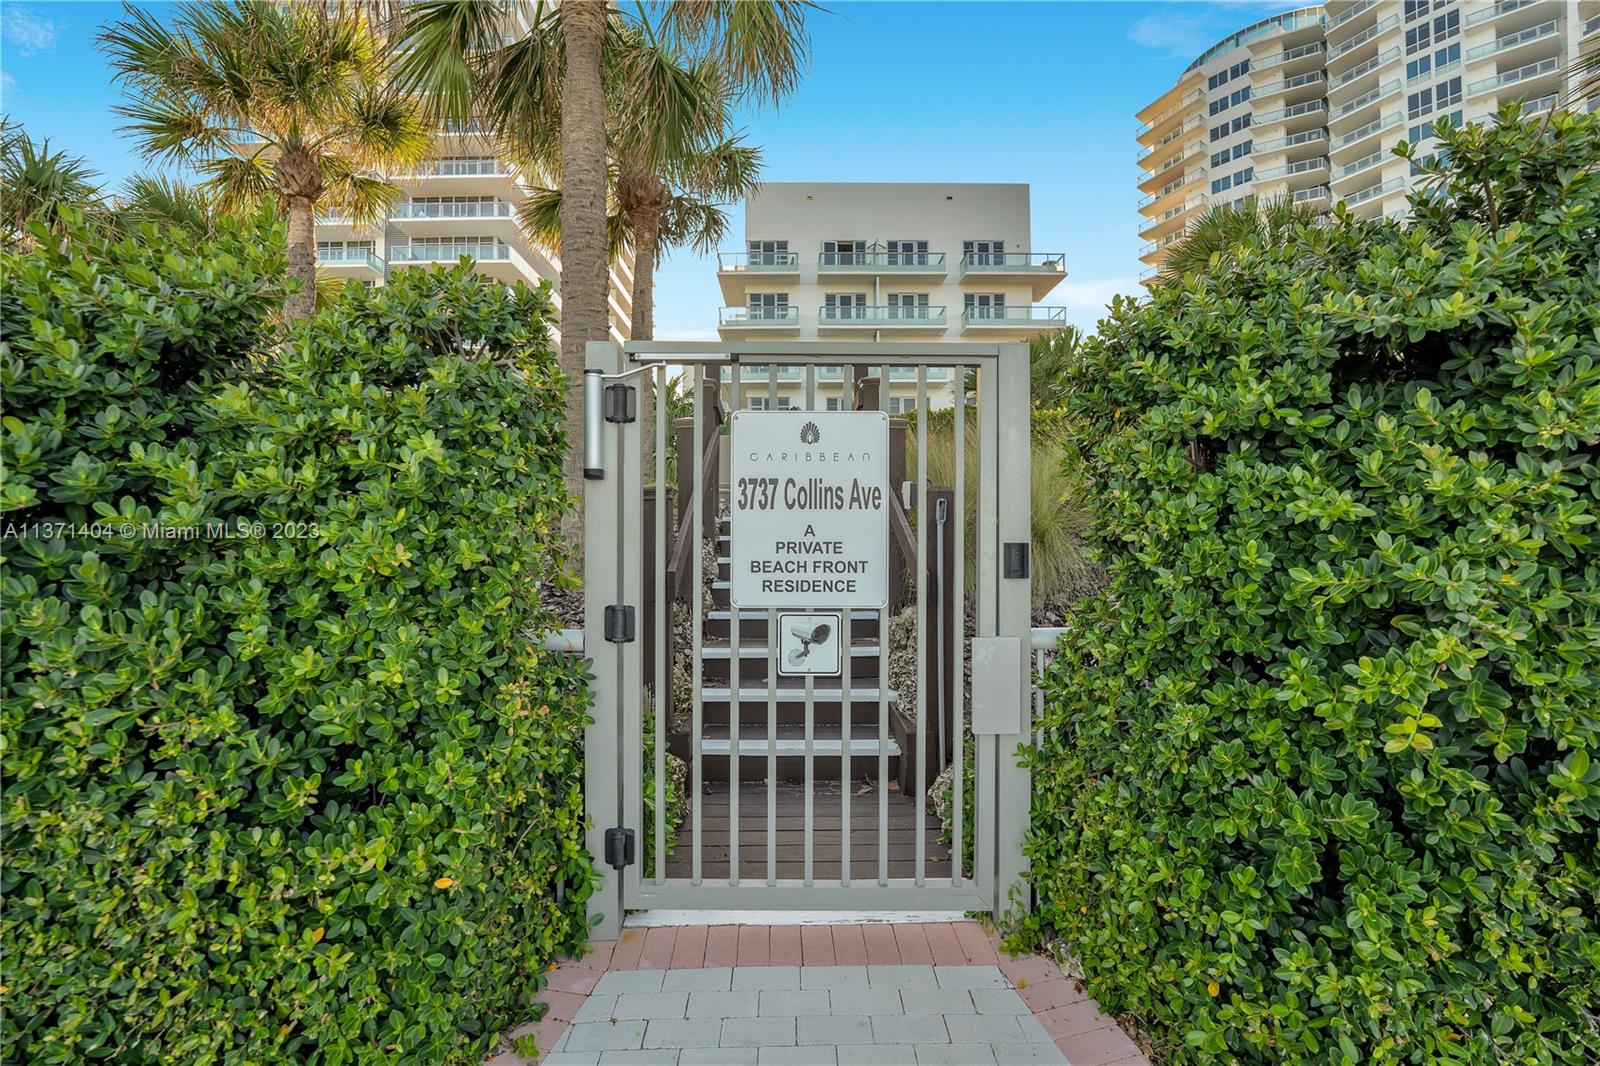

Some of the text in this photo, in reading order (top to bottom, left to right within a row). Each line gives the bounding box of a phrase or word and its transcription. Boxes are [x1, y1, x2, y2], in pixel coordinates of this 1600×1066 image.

[750, 452, 870, 462] CARIBBEAN
[738, 477, 882, 511] 3737 Collins Ave
[803, 524, 816, 537] A
[775, 541, 843, 555] PRIVATE
[750, 560, 869, 574] BEACH FRONT
[762, 579, 857, 593] RESIDENCE
